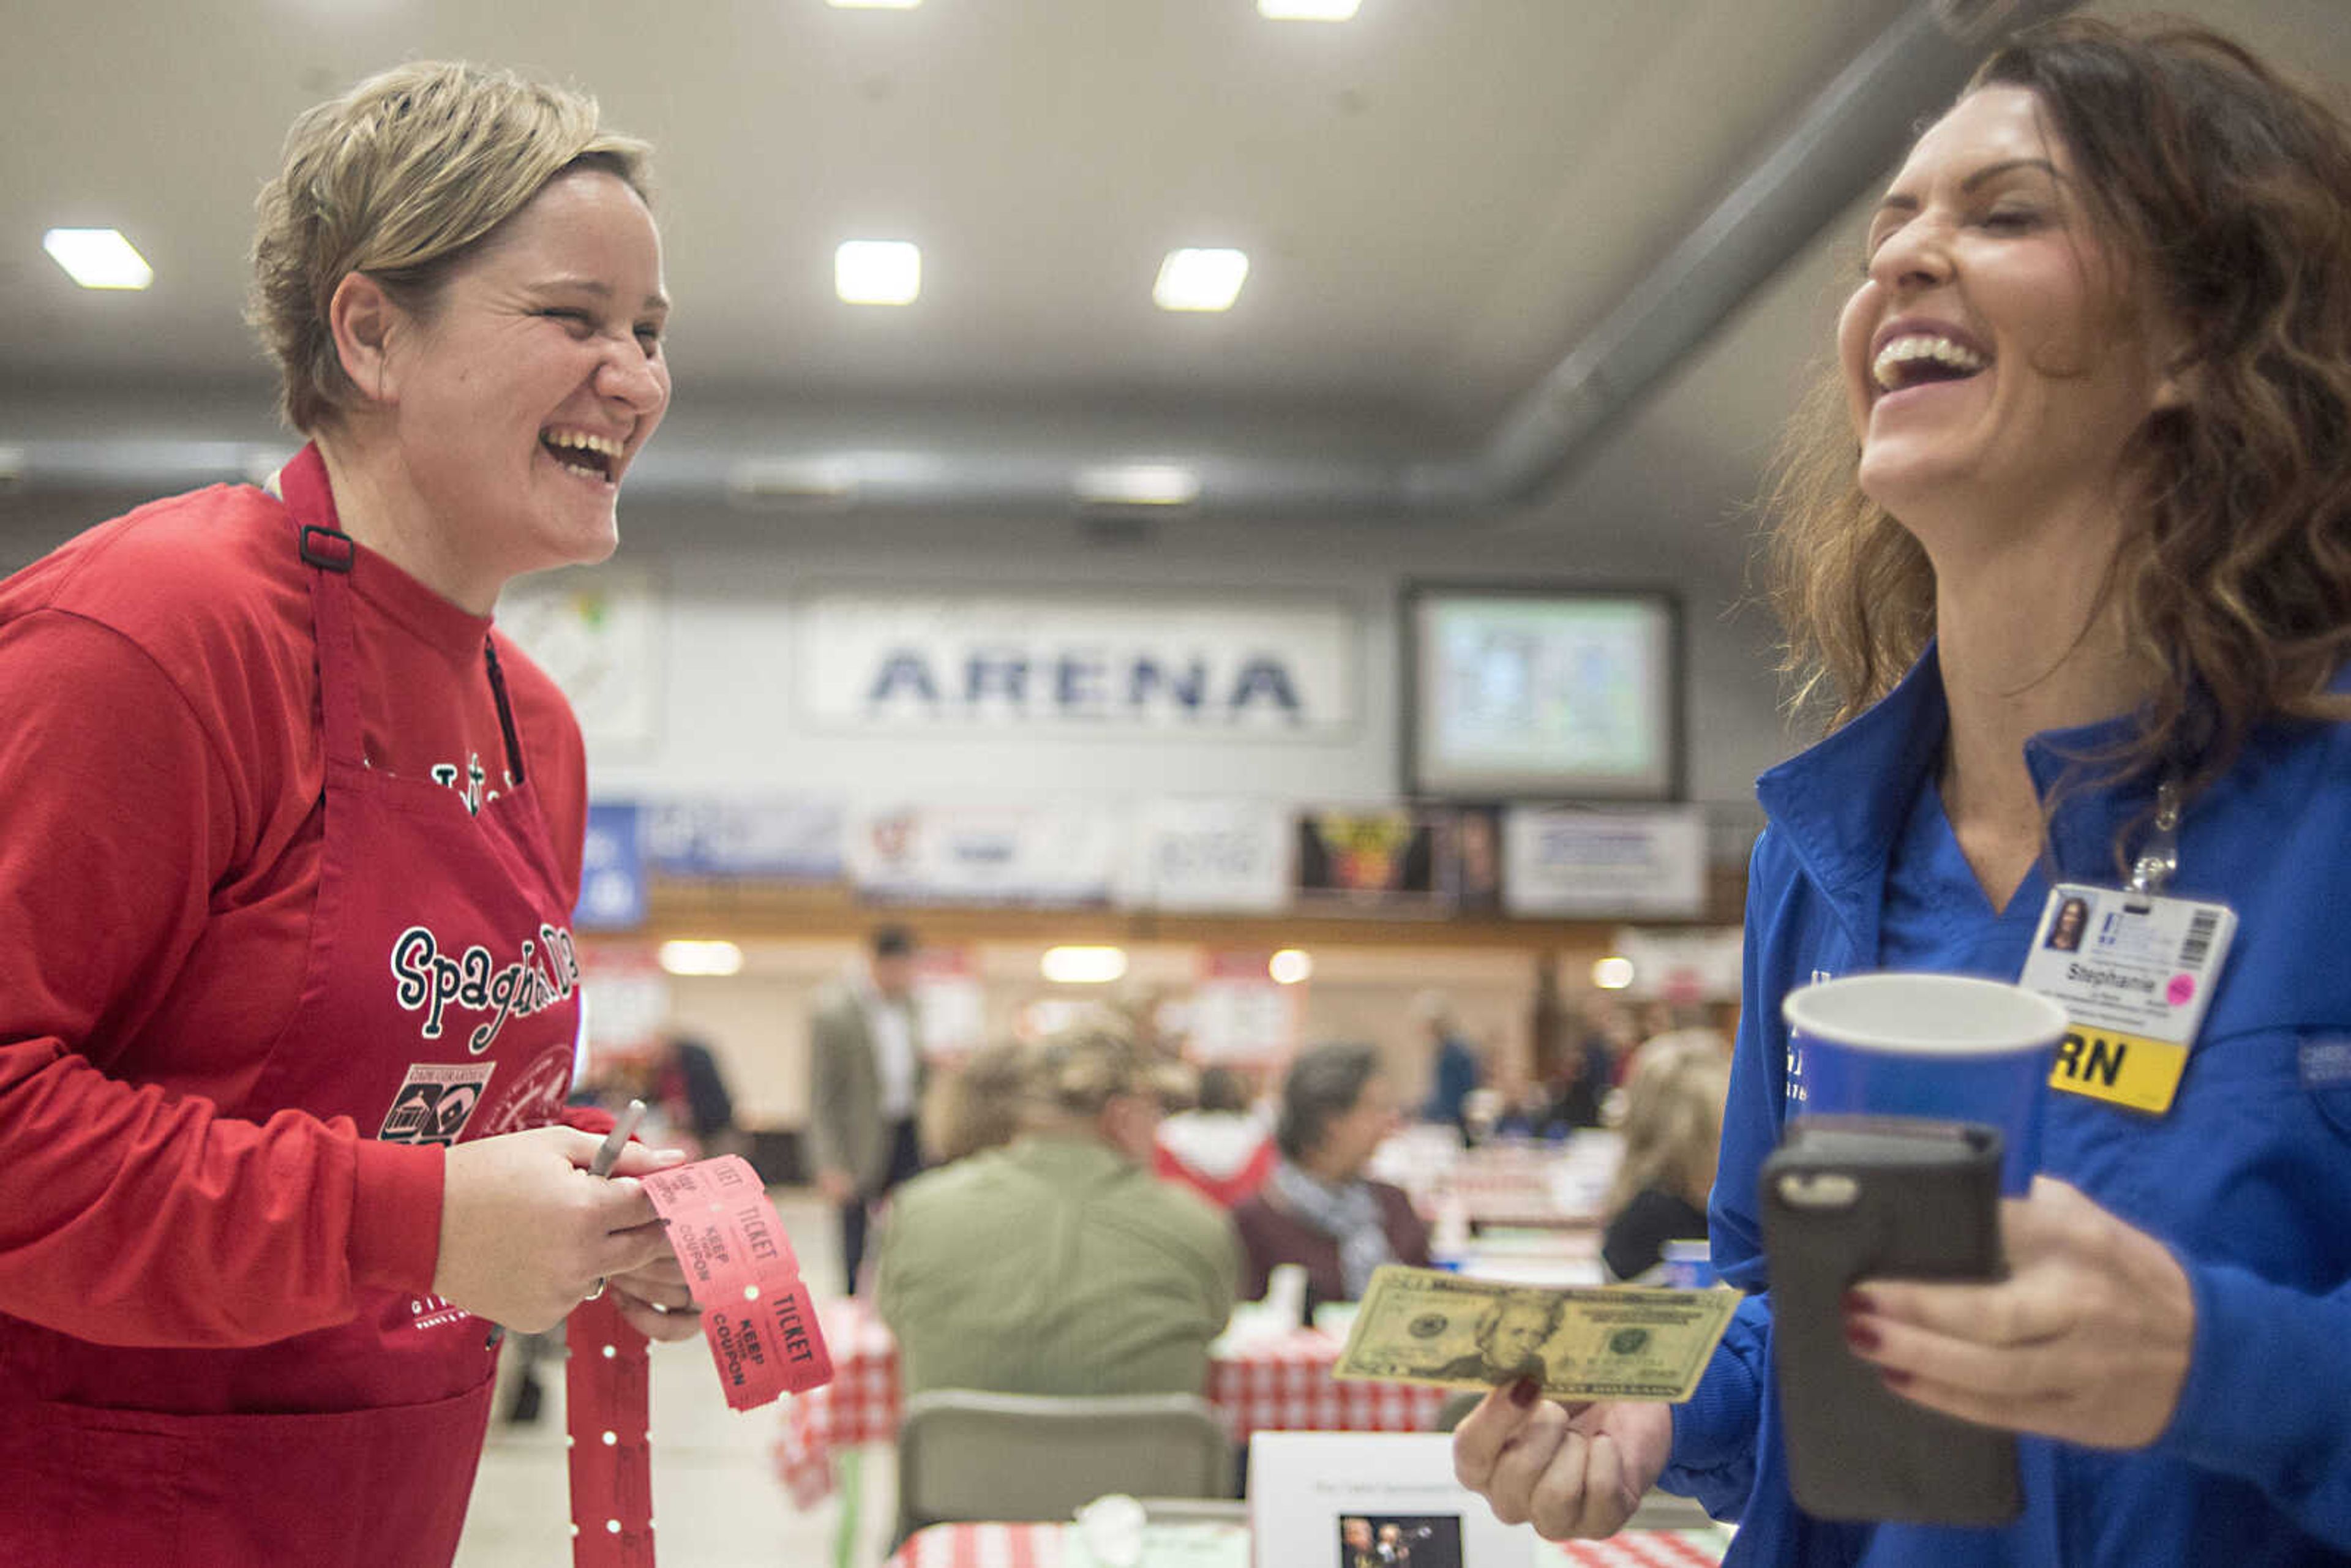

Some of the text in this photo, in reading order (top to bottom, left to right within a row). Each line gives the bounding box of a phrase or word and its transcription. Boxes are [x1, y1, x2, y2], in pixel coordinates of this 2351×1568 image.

[866, 647, 1304, 719] ARENA
[2055, 1033, 2127, 1087] RN
[679, 1224, 711, 1281] COUPON
[737, 1206, 777, 1258] TICKET
[714, 1312, 745, 1386] COUPON
[740, 1319, 765, 1365] KEEP
[773, 1293, 813, 1363] TICKET
